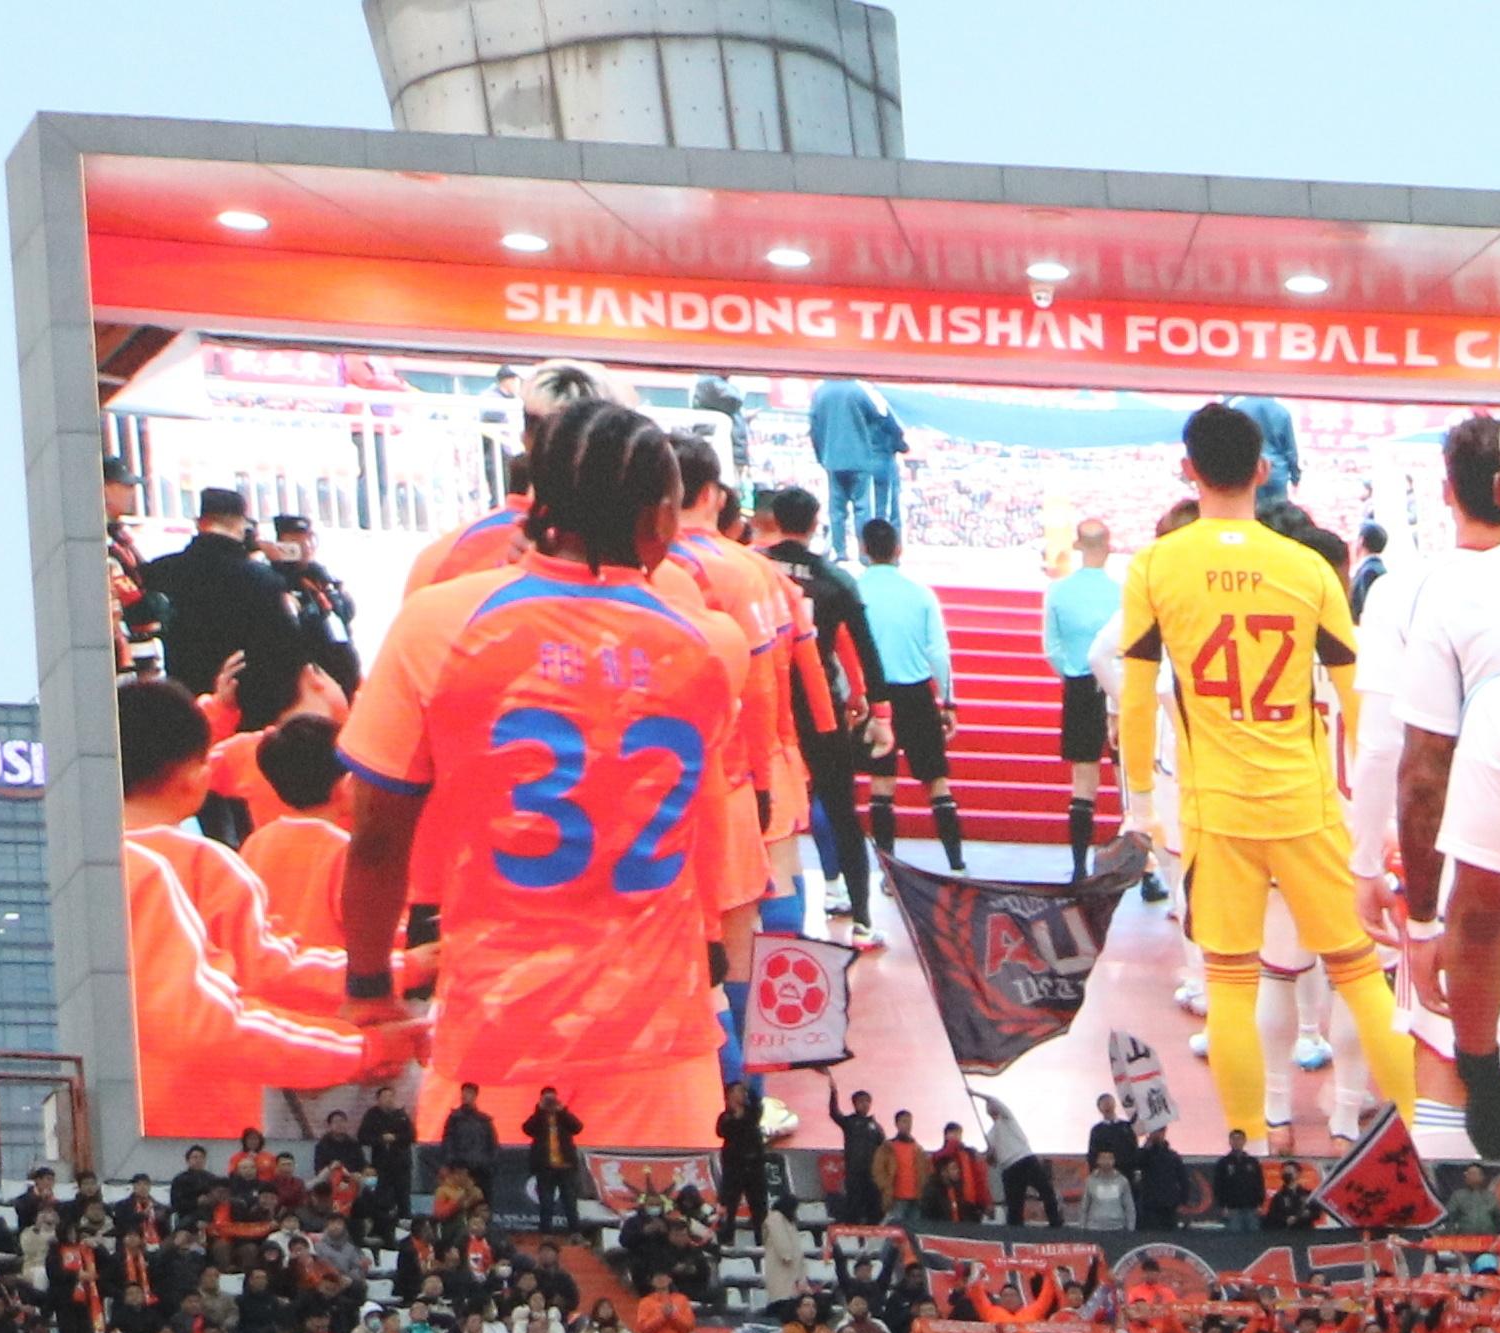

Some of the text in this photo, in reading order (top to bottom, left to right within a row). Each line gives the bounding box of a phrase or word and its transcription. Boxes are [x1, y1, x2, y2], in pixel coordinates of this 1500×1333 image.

[504, 283, 836, 338] SHANDONG
[857, 302, 1104, 350] TAISHAN
[1124, 316, 1439, 369] FOOTBALL
[1206, 570, 1263, 593] POPP
[1192, 615, 1295, 721] 42
[491, 707, 705, 893] 32
